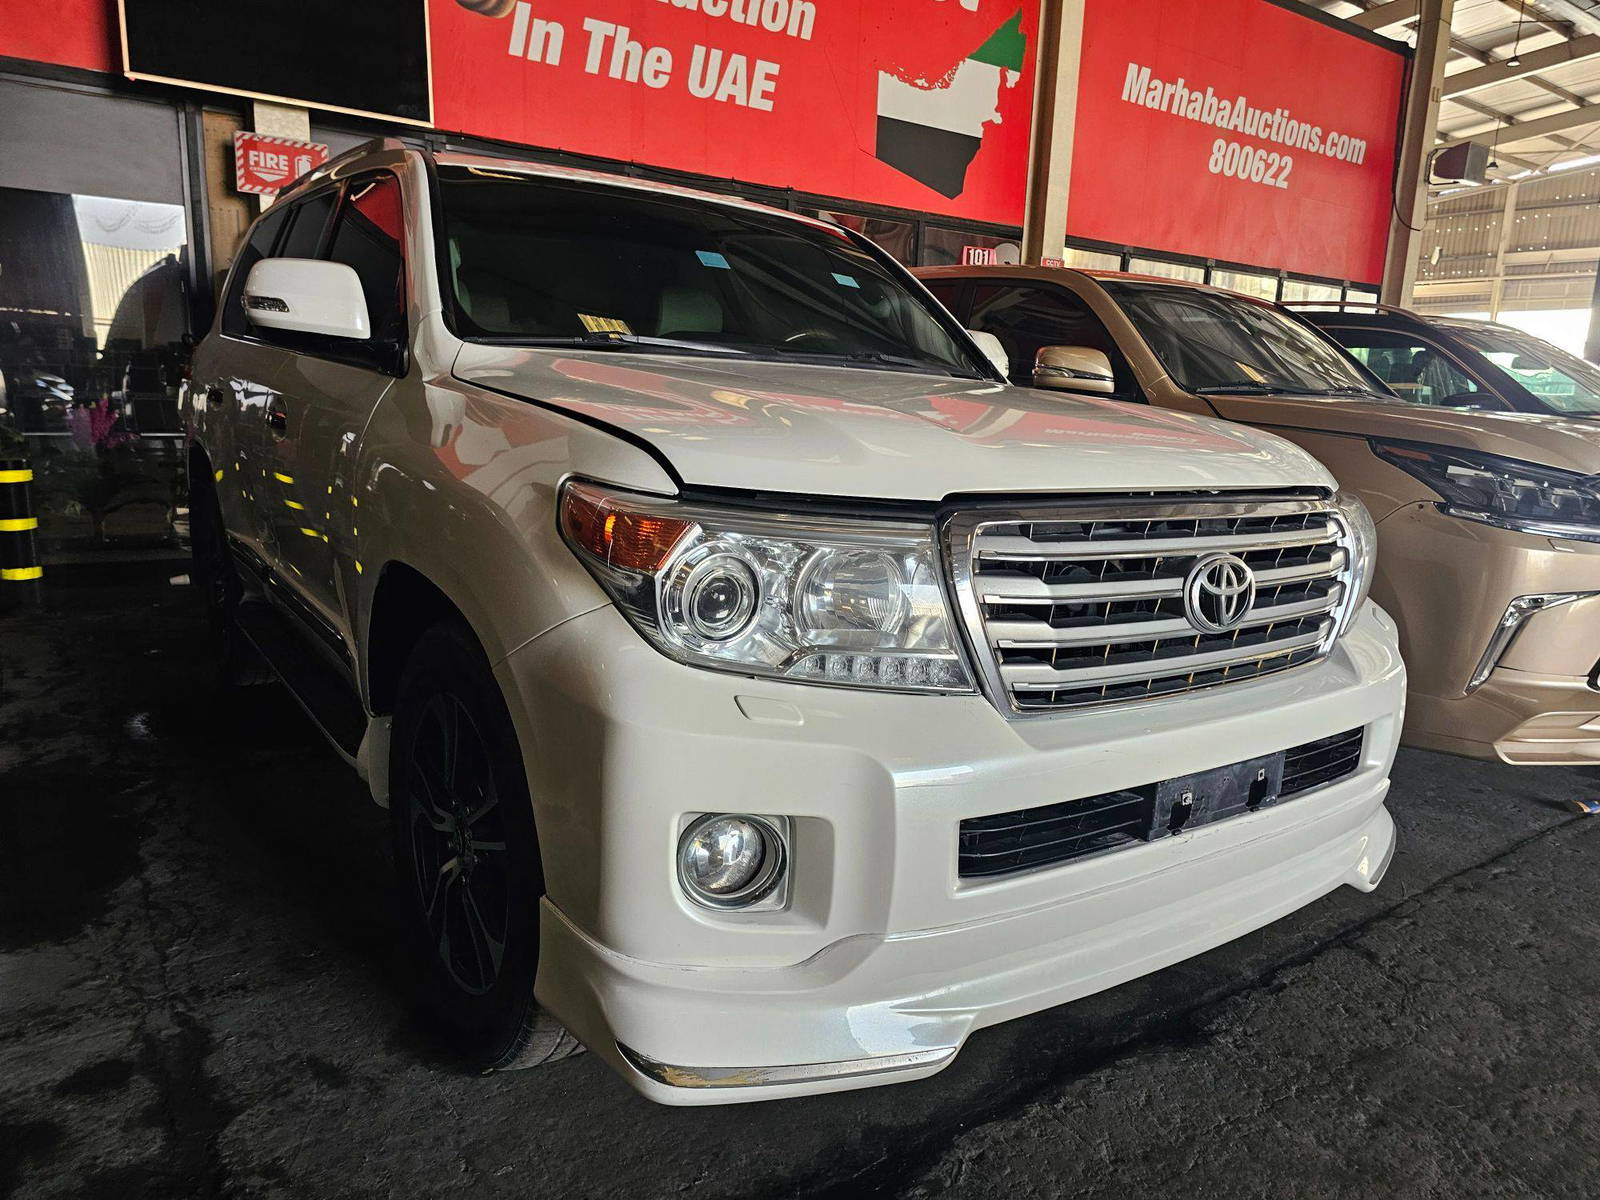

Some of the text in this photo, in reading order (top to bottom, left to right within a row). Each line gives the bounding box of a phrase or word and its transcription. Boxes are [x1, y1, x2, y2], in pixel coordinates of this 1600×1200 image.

[508, 1, 781, 112] In The UAE
[1121, 62, 1367, 165] MarhabaAuctions.com
[248, 150, 289, 170] FIRE
[1208, 138, 1293, 189] 800622
[968, 248, 990, 266] 101
